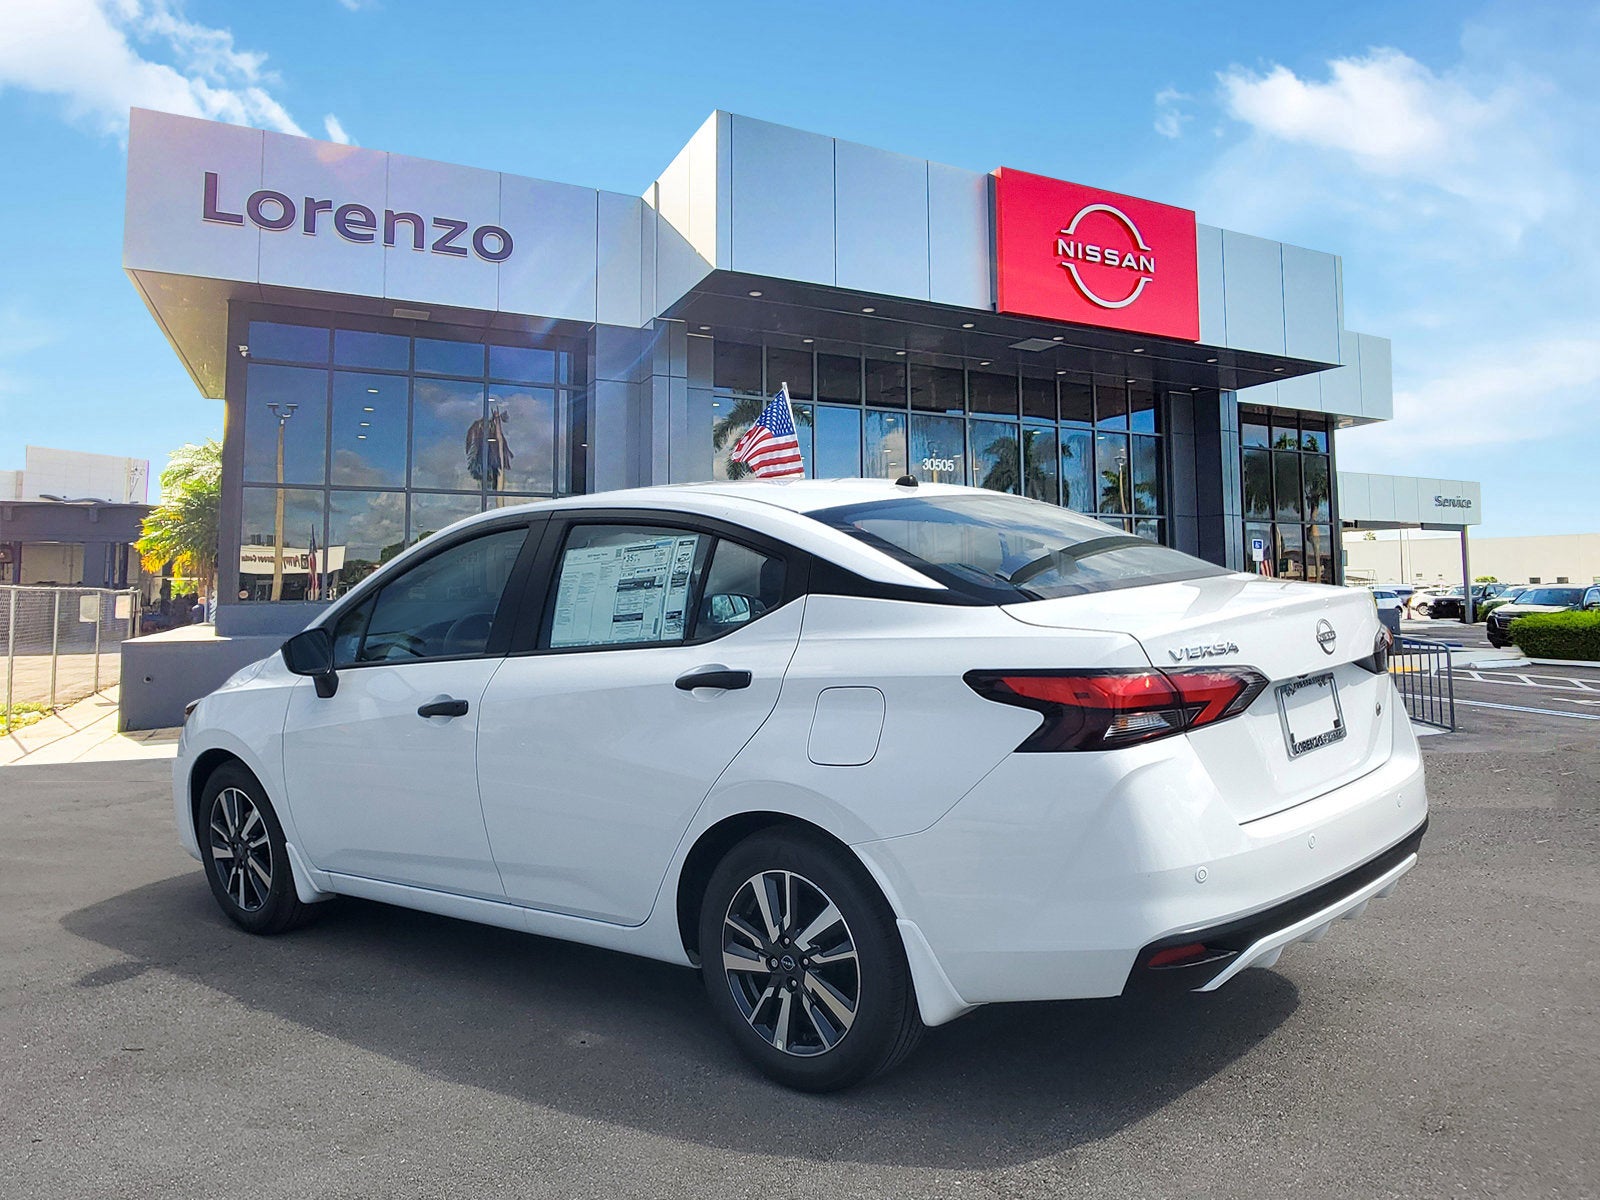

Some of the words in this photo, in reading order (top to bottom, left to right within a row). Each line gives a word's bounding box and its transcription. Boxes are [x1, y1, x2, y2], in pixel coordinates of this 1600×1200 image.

[203, 171, 514, 262] Lorenzo
[1057, 238, 1155, 273] NISSAN
[922, 458, 954, 471] 30505
[1434, 495, 1472, 508] Service
[1168, 642, 1239, 663] VERSA
